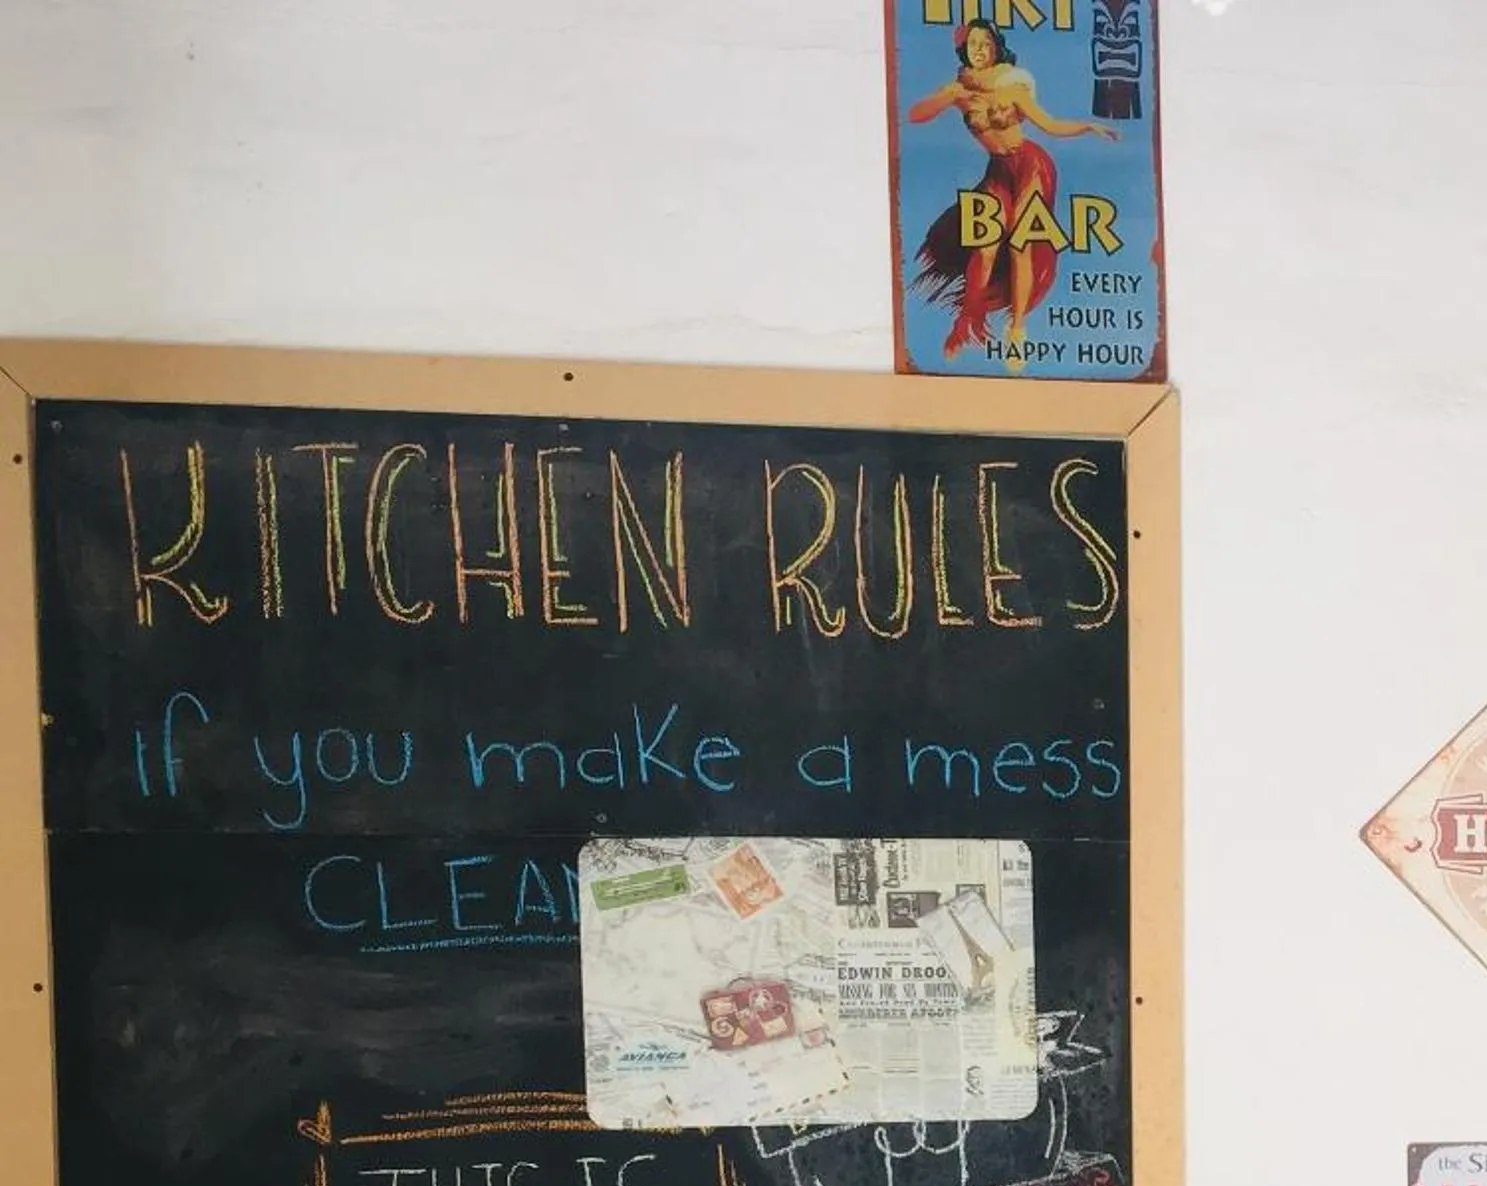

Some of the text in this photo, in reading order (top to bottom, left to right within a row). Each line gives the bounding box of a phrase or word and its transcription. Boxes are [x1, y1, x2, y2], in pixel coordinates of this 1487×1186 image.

[957, 190, 1124, 256] BAR
[1072, 272, 1142, 294] EVERY
[1049, 307, 1143, 330] HOUR IS
[986, 341, 1143, 365] HAPPY HOUR
[119, 440, 1121, 642] KITCHEN RULES
[253, 727, 414, 831] you
[465, 702, 741, 792] make
[797, 734, 853, 793] a
[906, 737, 1122, 799] mess
[838, 966, 951, 980] EDWIN DROO
[1438, 1156, 1463, 1171] the
